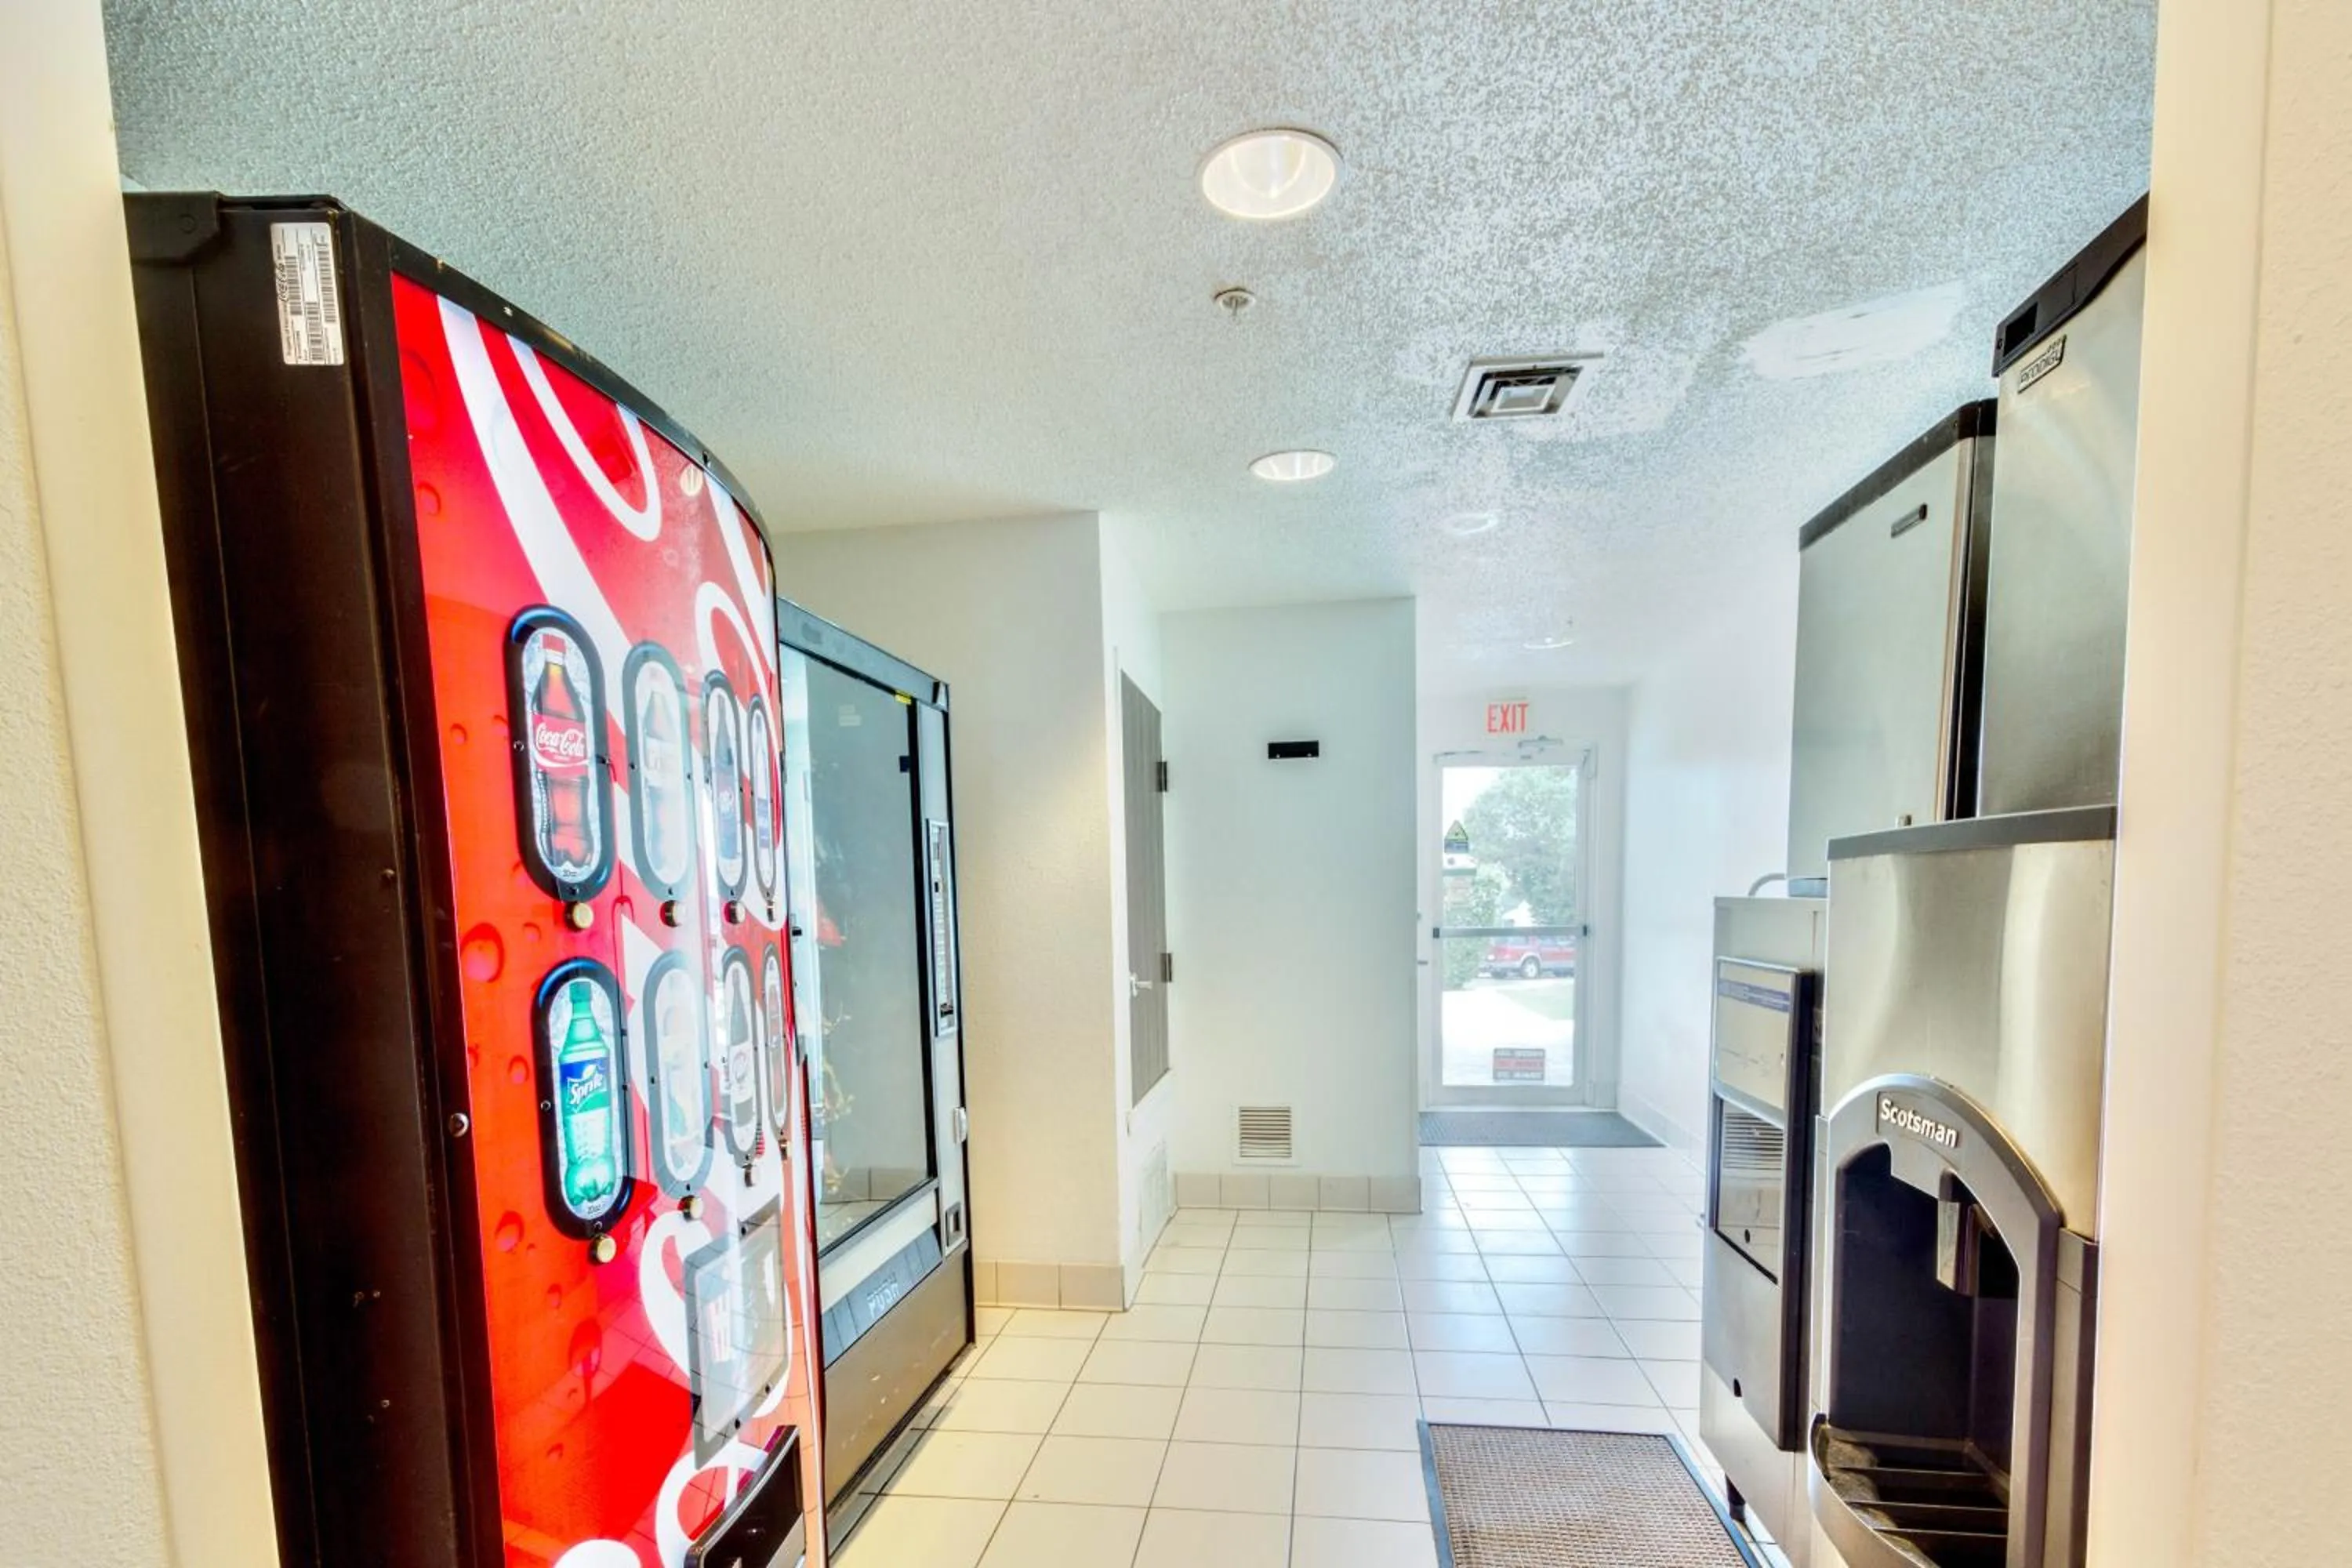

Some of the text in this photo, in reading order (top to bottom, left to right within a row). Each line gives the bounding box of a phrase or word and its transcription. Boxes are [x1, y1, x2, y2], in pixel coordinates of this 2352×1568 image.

[1486, 703, 1530, 733] EXIT
[535, 721, 585, 757] Coca-Cola
[570, 1072, 604, 1105] Sprite
[1881, 1098, 1958, 1148] Scotsman
